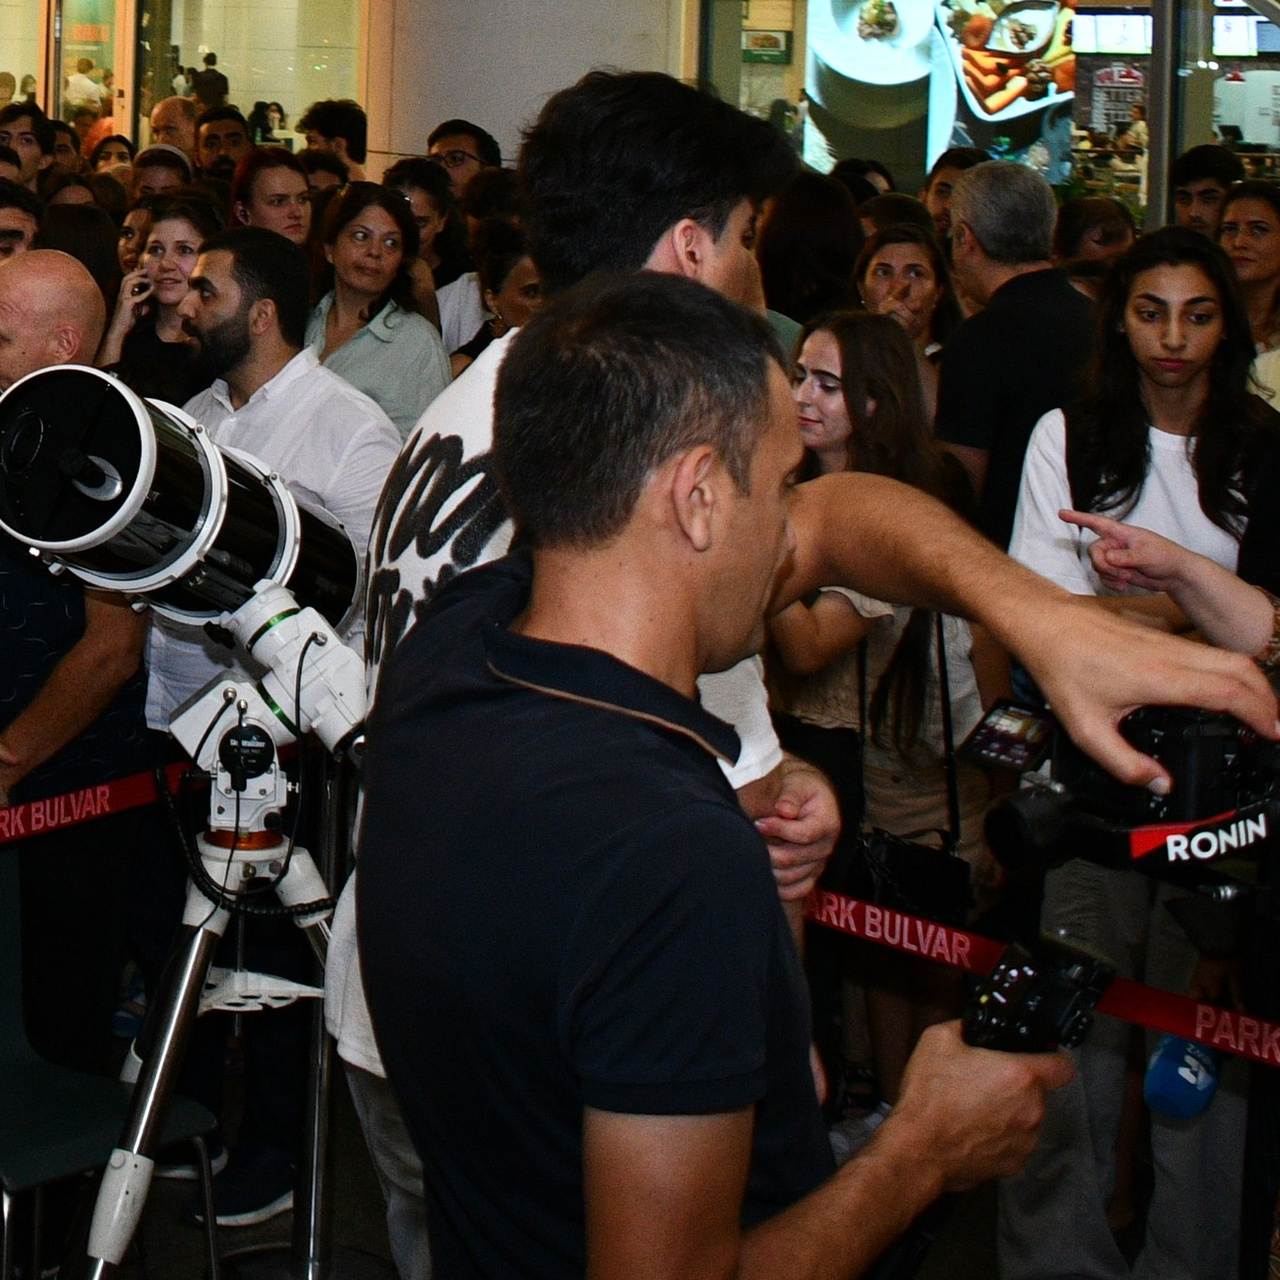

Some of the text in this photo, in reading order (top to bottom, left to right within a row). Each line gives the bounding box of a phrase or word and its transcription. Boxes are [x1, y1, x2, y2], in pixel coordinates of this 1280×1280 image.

[31, 784, 110, 831] BULVAR
[1166, 812, 1268, 862] RONIN
[864, 904, 971, 969] BULVAR
[1195, 1004, 1280, 1065] PARK
